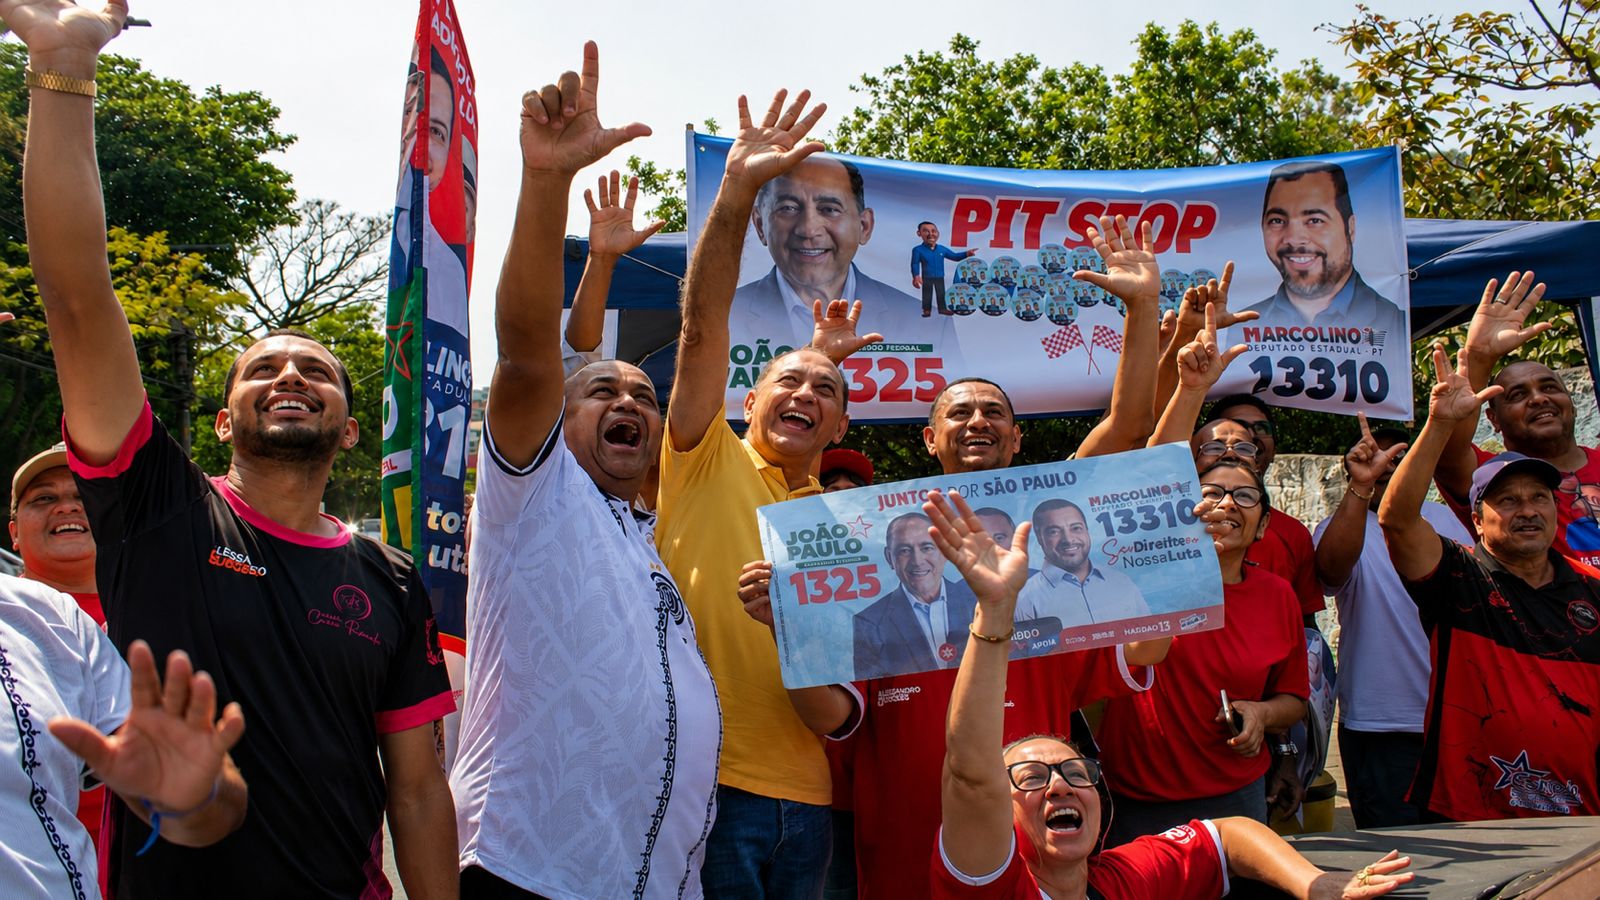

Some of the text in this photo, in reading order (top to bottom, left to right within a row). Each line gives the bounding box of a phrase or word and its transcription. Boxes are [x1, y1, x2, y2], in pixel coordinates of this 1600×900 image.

[949, 196, 1218, 255] PIT STOP
[1242, 326, 1362, 345] MARCOLINO
[729, 338, 795, 366] OÃ
[1247, 343, 1305, 352] DEPUTADO
[1310, 344, 1361, 355] ESTADUAL
[1371, 348, 1383, 356] PT
[842, 356, 948, 403] 325
[1248, 355, 1390, 405] 13310
[982, 476, 1017, 496] SÃO
[1021, 470, 1077, 492] PAULO
[1088, 484, 1172, 507] MARCOLINO
[1095, 498, 1198, 537] 13310
[786, 522, 849, 546] JOÃO
[786, 537, 863, 561] PAULO
[789, 563, 882, 606] 1325
[1158, 620, 1171, 632] 13
